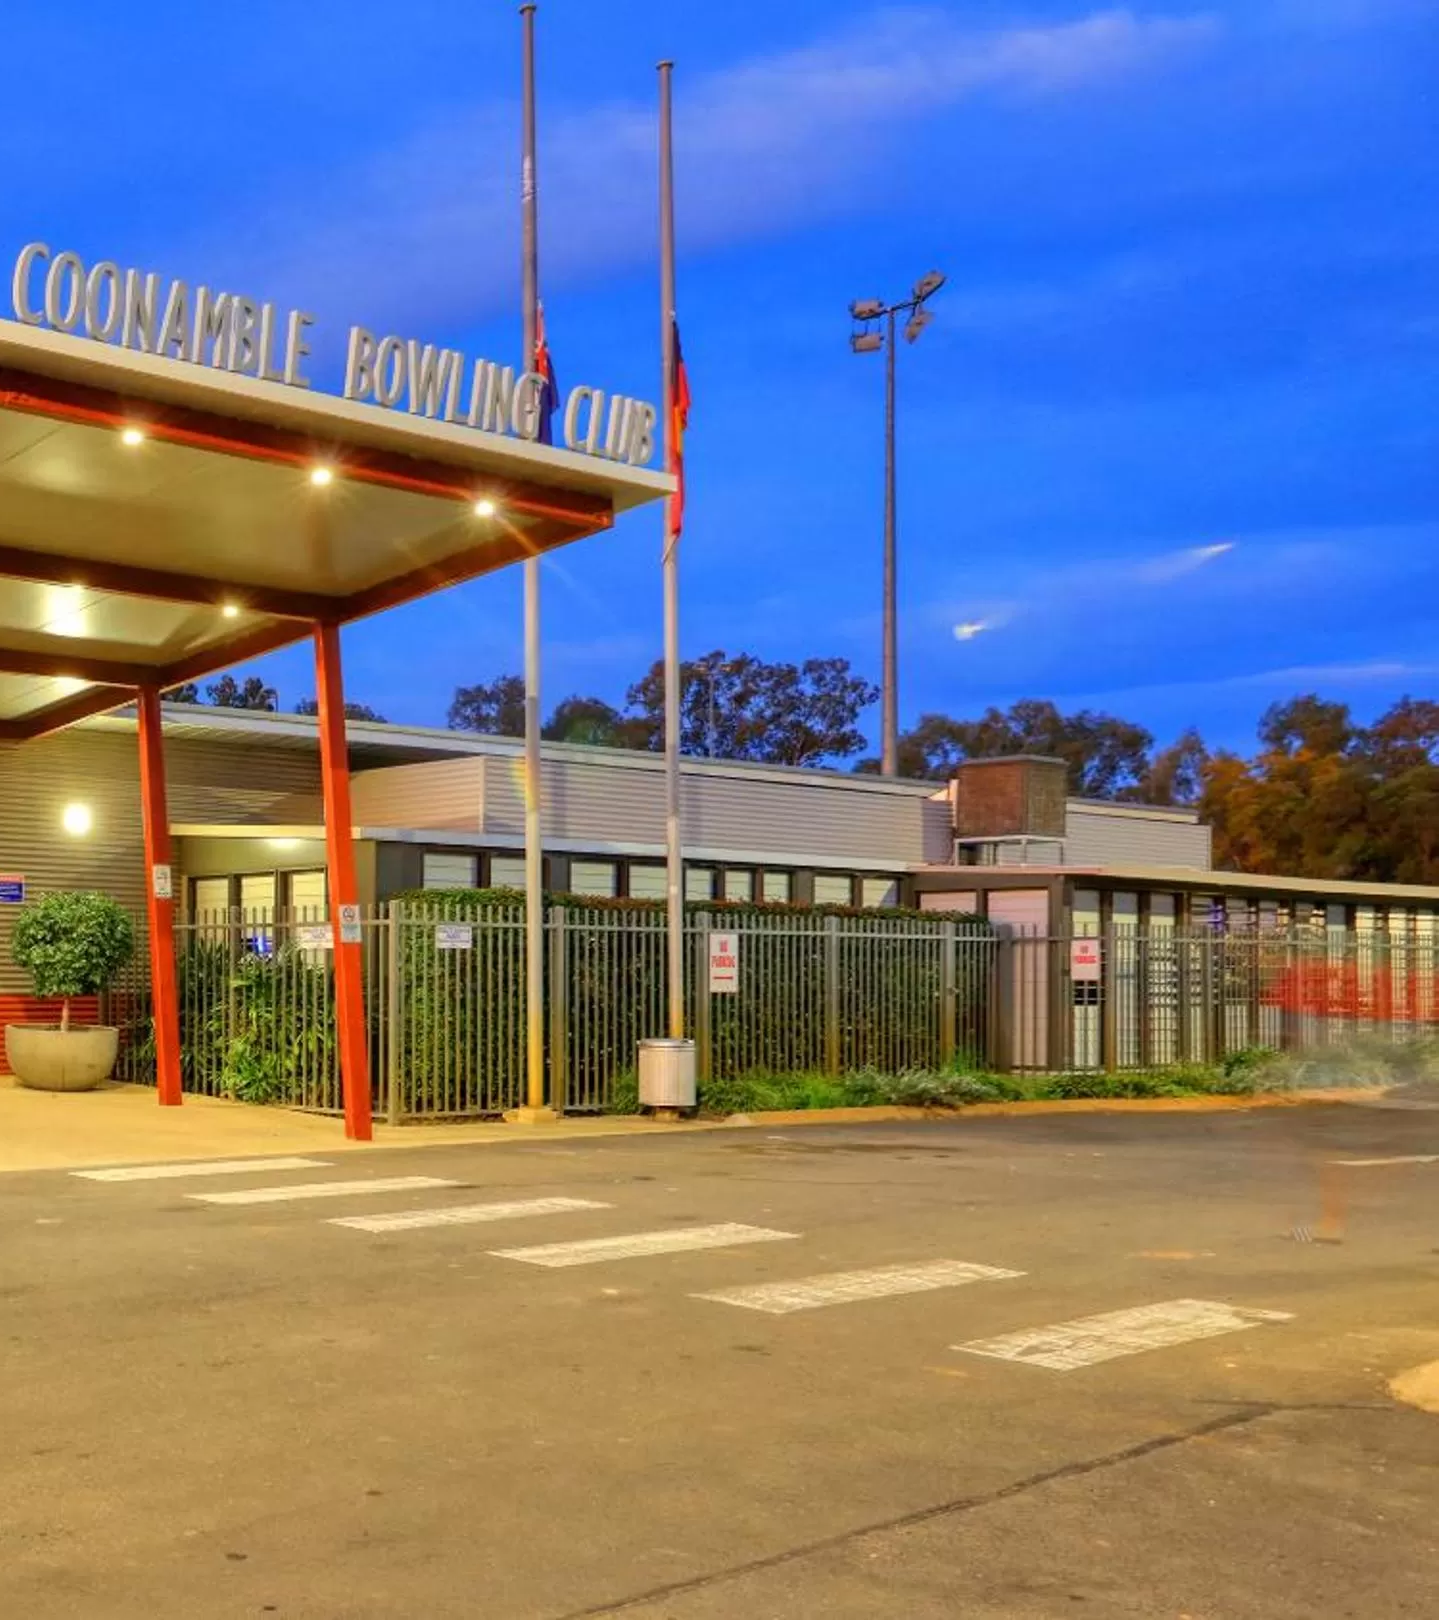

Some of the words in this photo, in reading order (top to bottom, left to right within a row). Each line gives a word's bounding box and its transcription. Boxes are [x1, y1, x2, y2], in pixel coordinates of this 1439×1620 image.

[12, 242, 316, 389] COONAMBLE
[344, 325, 548, 441] BOWLING
[564, 385, 656, 466] CLUB
